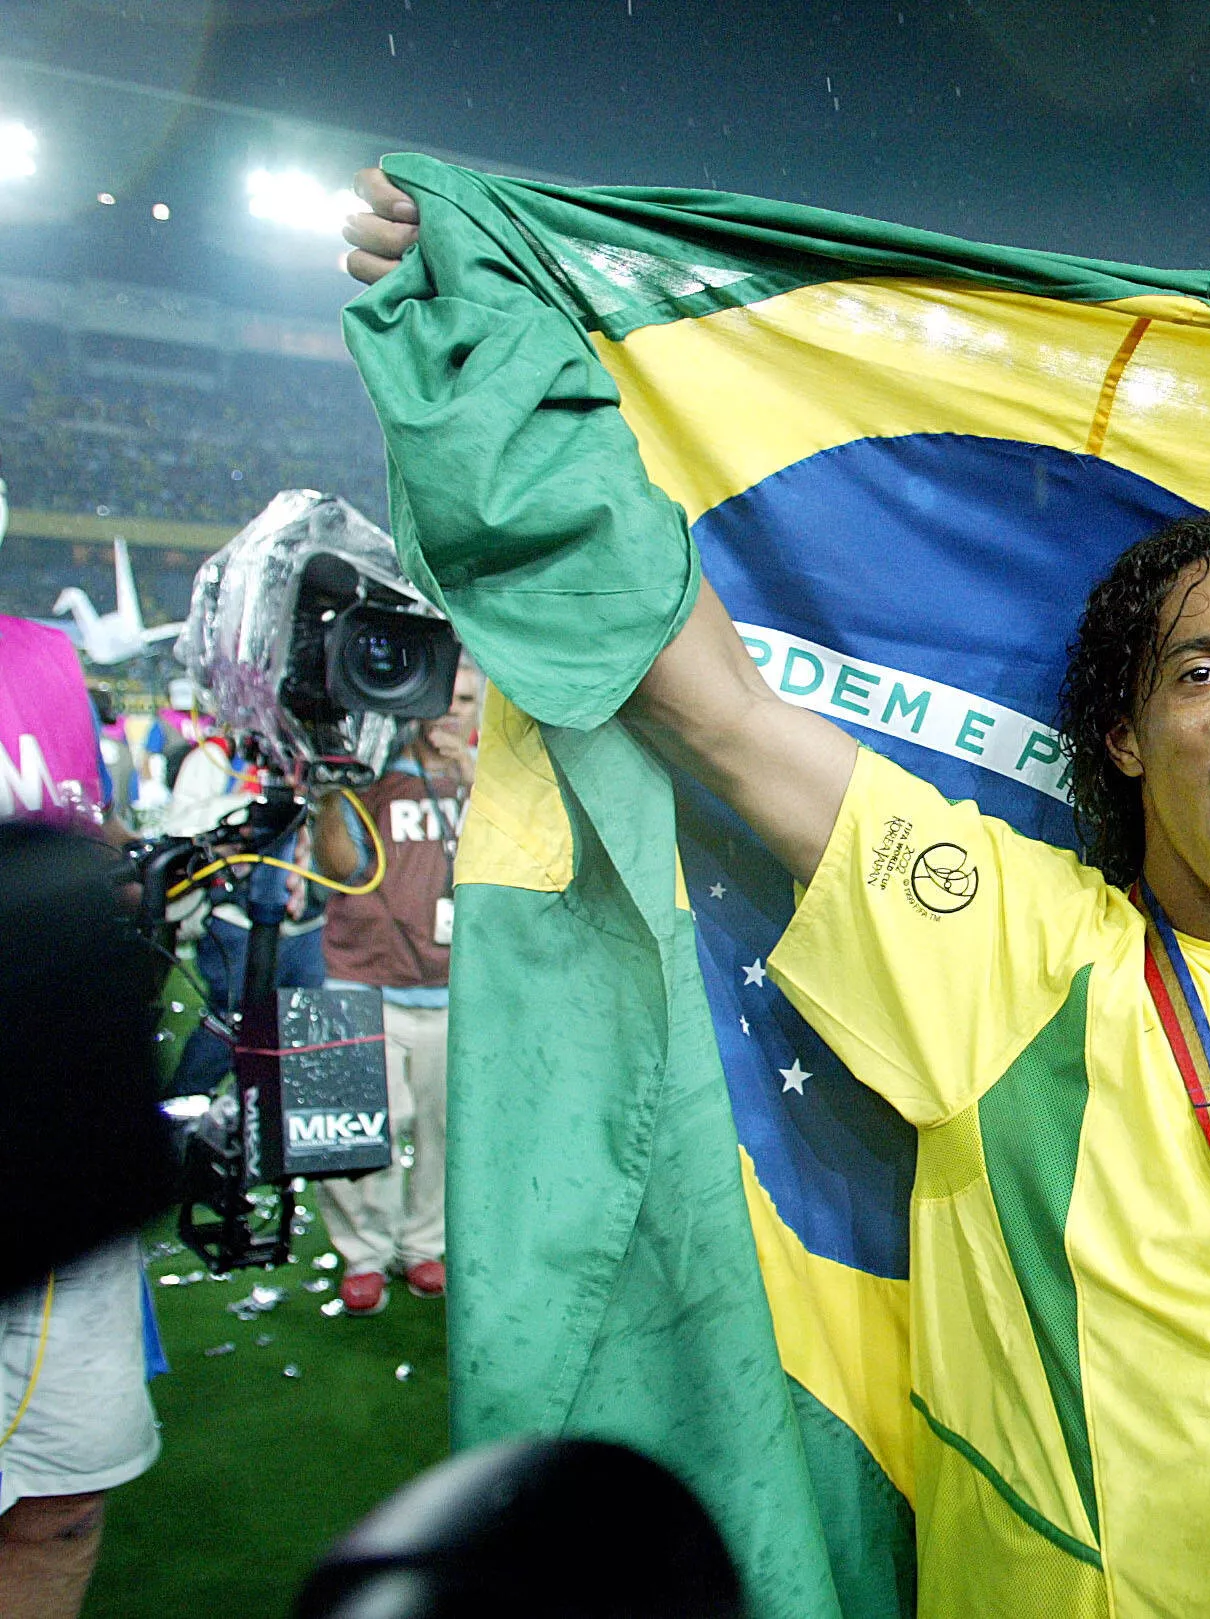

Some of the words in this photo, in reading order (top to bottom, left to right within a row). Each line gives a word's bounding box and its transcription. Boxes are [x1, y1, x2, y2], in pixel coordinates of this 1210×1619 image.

[955, 709, 996, 756] E
[900, 823, 913, 840] FIFA
[887, 843, 904, 872] WORLD
[880, 873, 891, 890] CUP
[289, 1112, 386, 1141] MK-V
